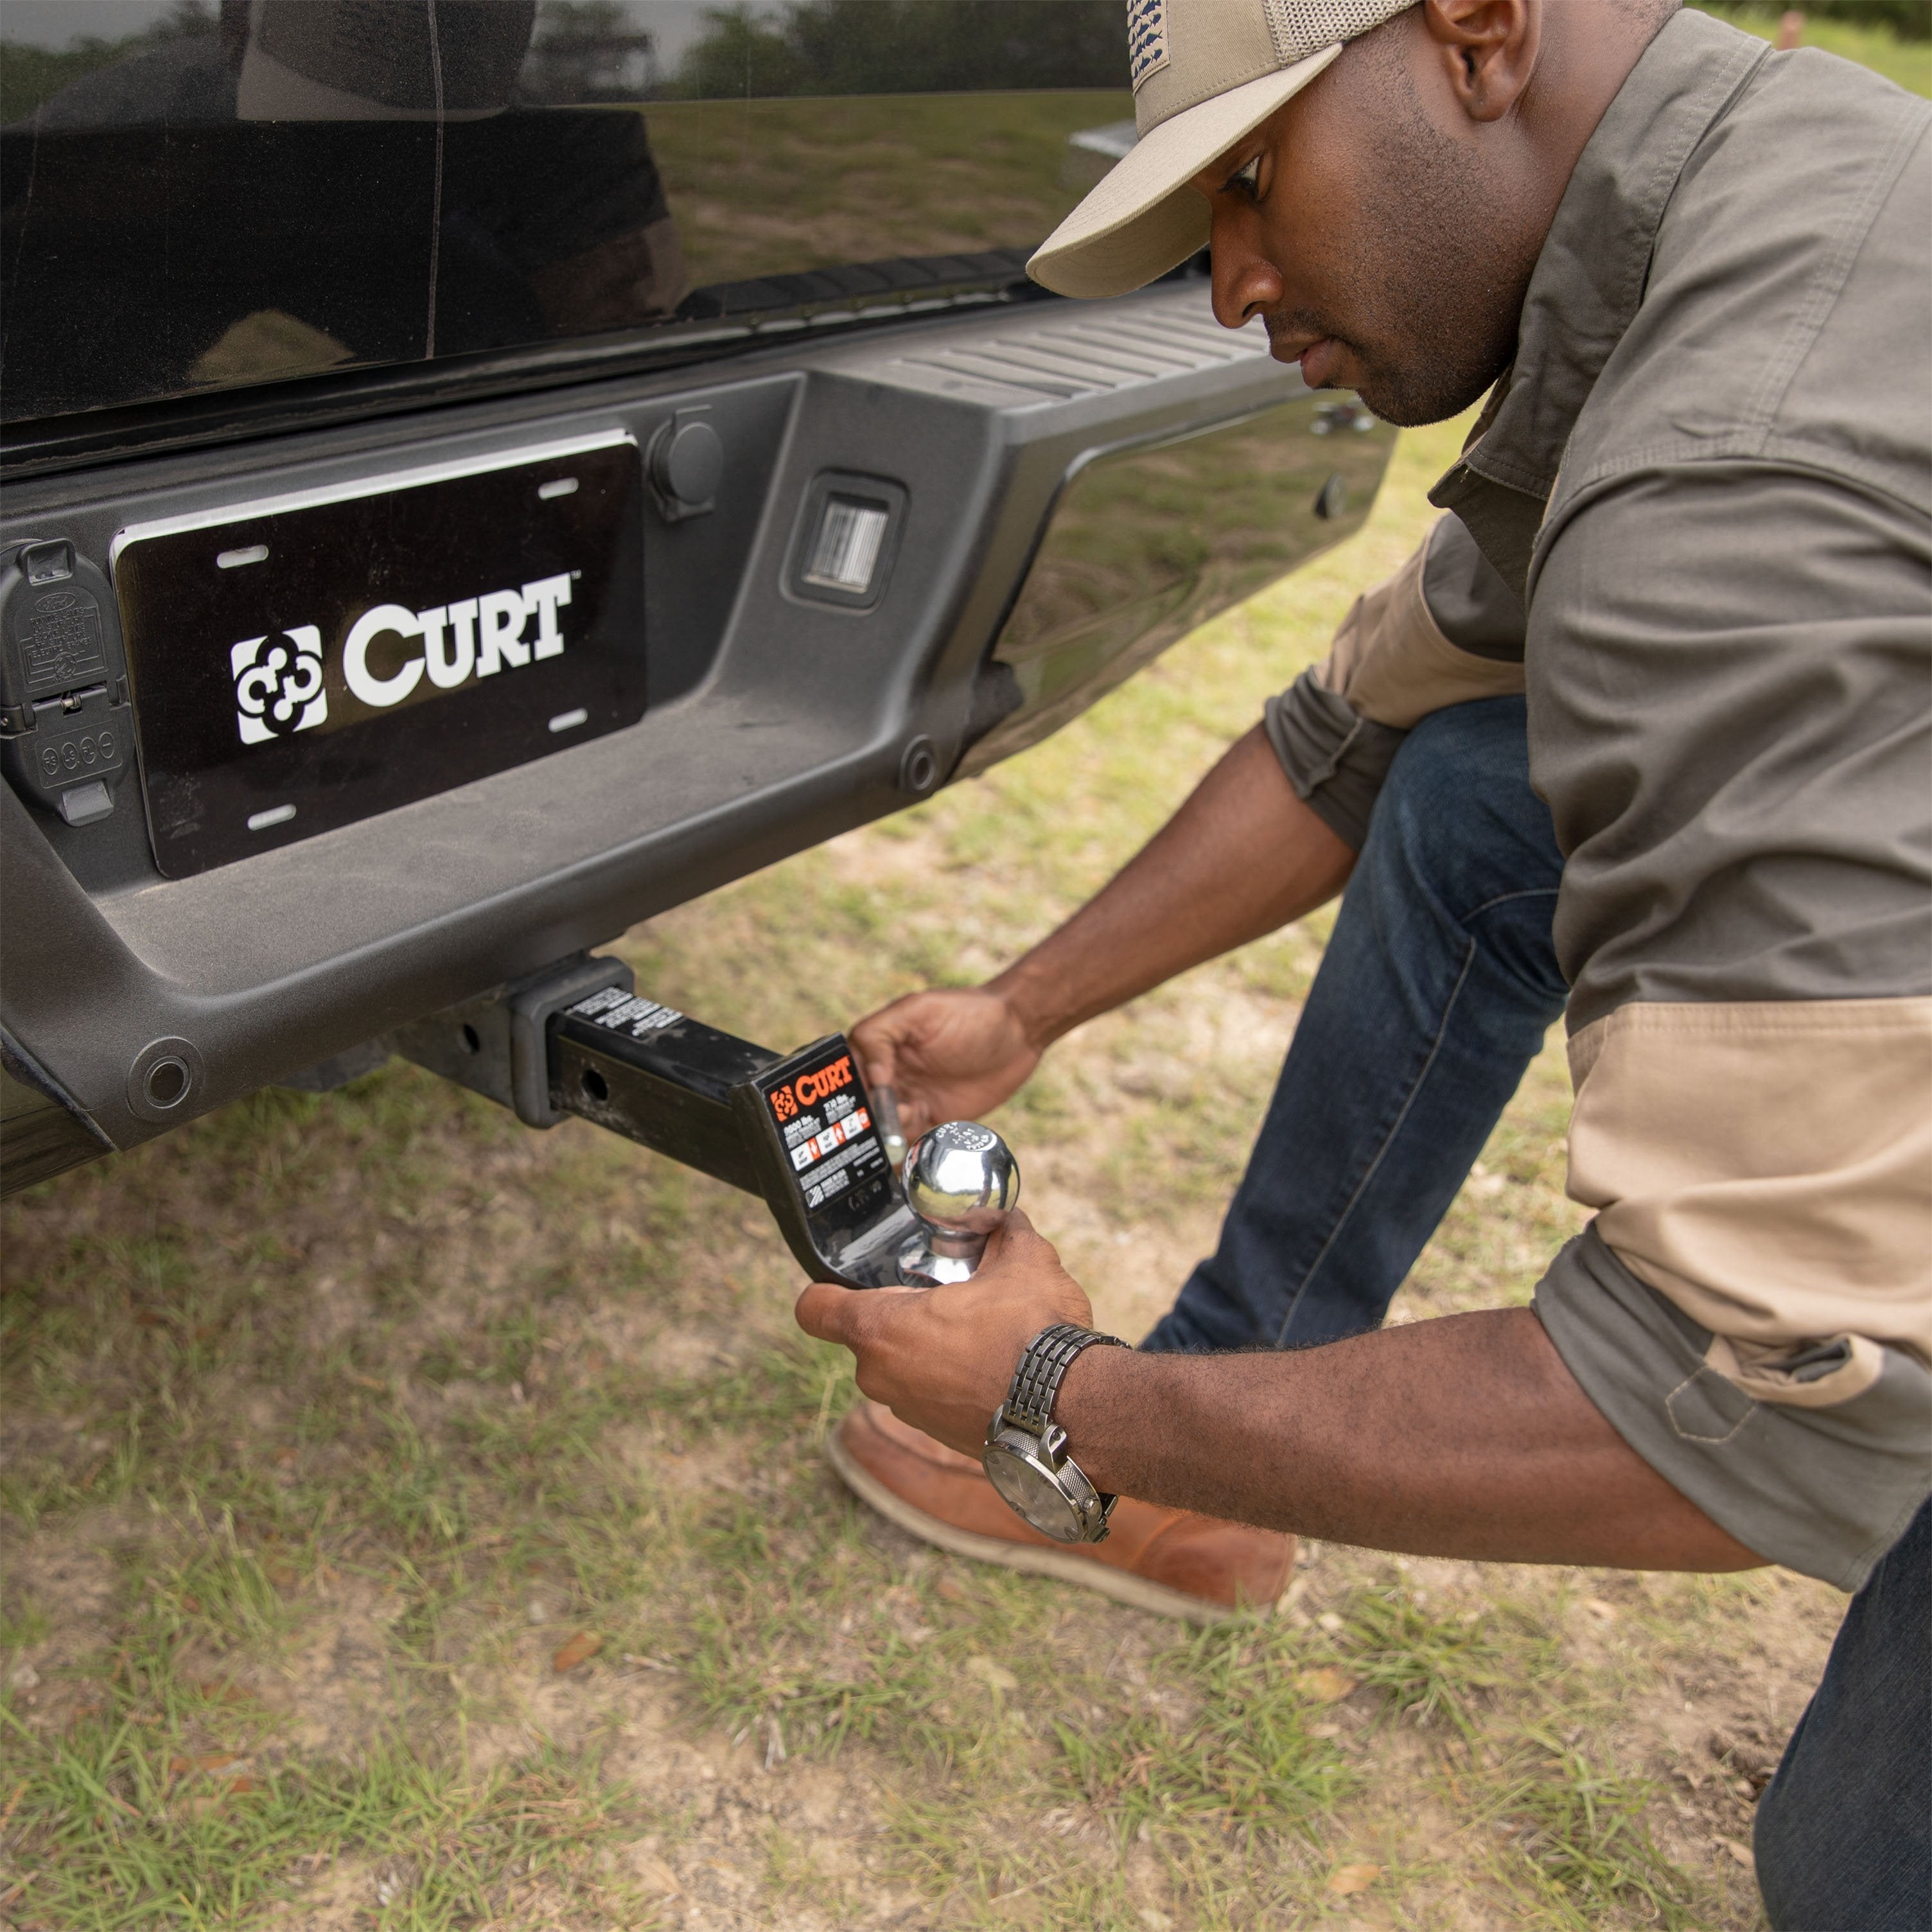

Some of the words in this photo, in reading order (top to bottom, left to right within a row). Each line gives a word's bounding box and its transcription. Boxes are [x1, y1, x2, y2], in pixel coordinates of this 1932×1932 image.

[30, 613, 58, 626] RUNNING
[61, 606, 85, 619] LAMPS
[62, 622, 86, 634] LAMPS
[31, 644, 64, 658] ELECTRIC
[66, 636, 92, 649] BRAKES
[342, 572, 572, 707] CURT
[44, 755, 57, 769] RS
[63, 750, 76, 762] LS
[795, 1055, 853, 1106] CURT
